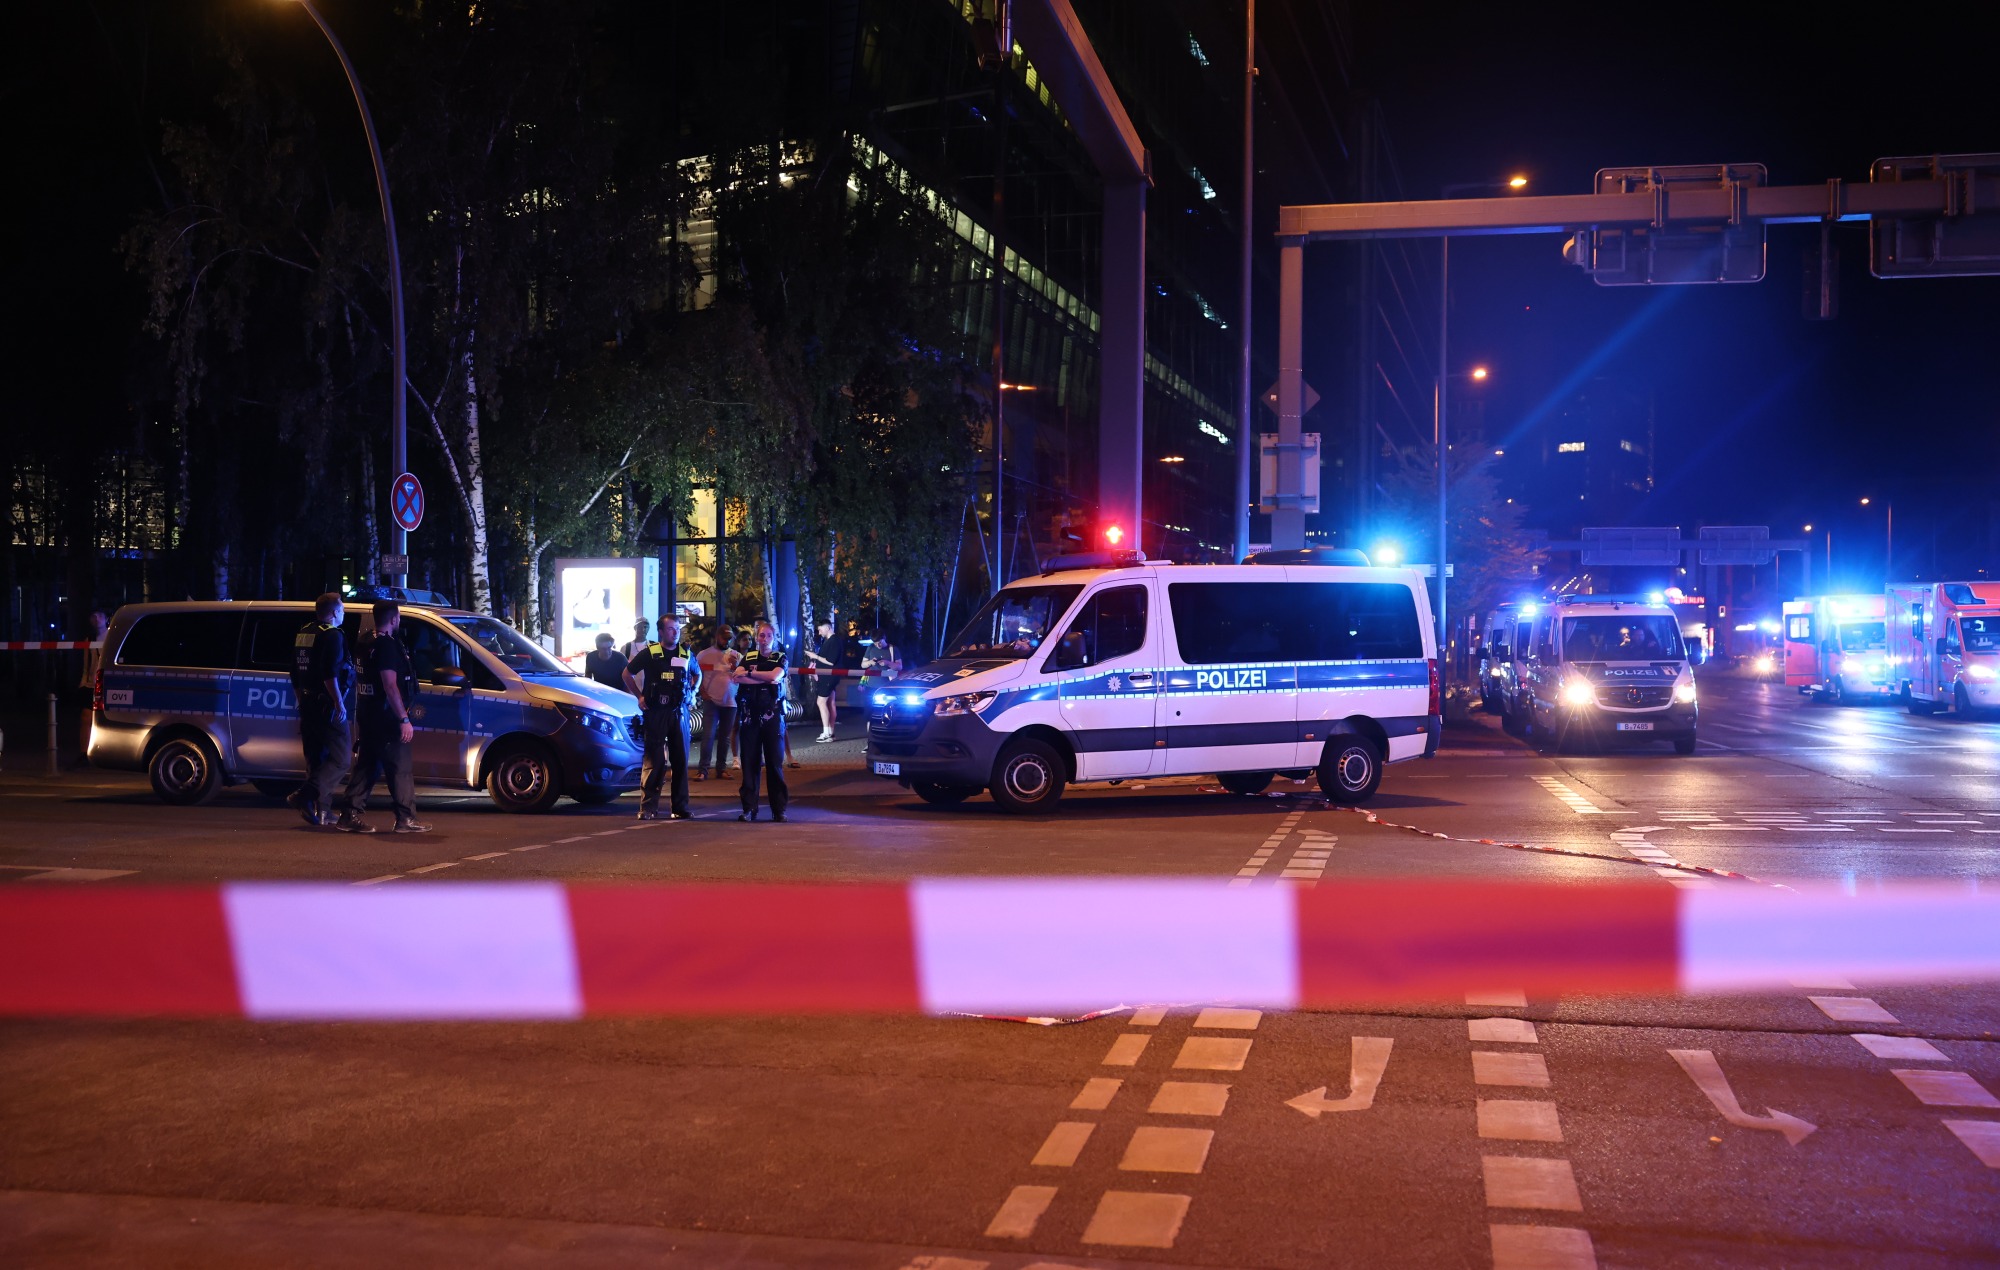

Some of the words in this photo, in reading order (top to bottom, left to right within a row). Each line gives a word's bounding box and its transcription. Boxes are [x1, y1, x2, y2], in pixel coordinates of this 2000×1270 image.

[1196, 670, 1267, 689] POLIZEI
[111, 693, 127, 701] OV1
[247, 688, 298, 710] POL
